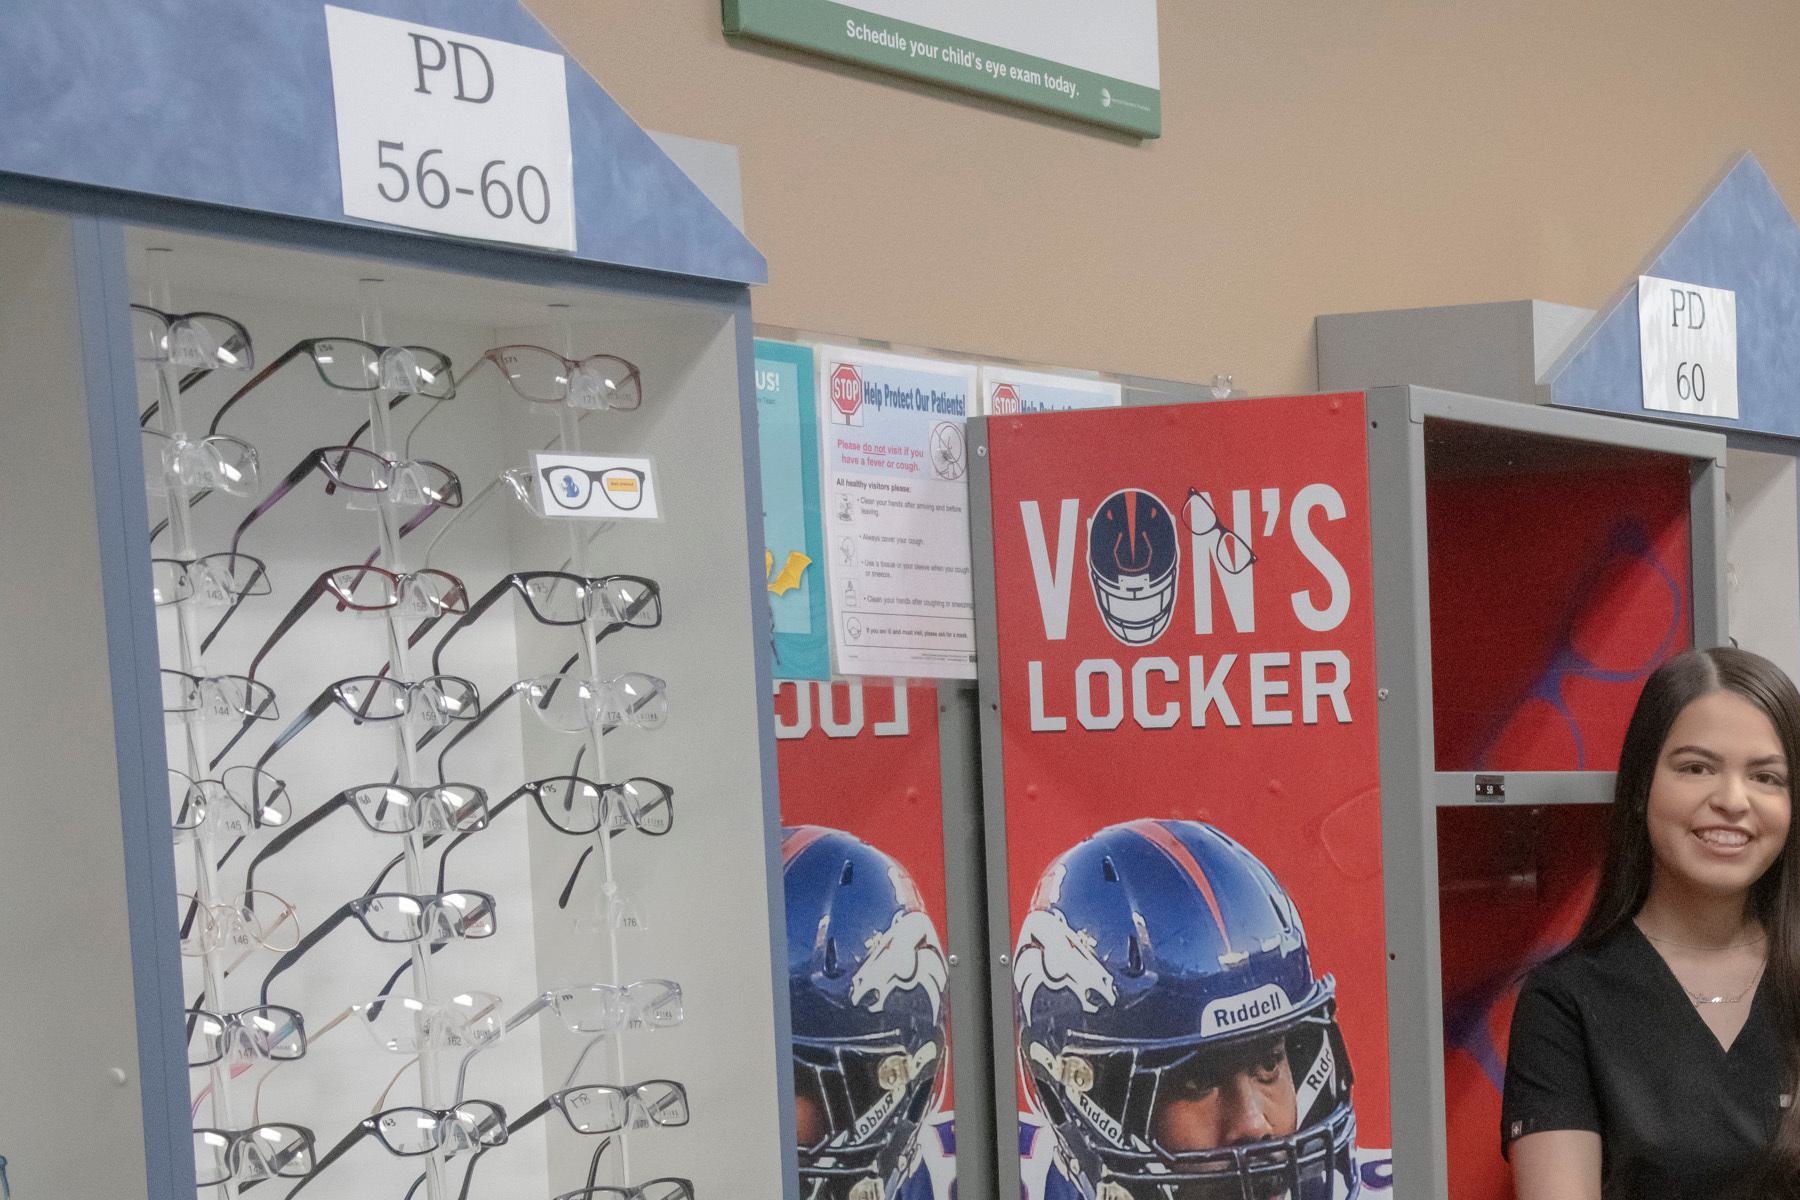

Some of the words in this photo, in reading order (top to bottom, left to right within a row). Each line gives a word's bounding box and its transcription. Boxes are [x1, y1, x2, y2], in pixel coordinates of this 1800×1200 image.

[846, 19, 906, 51] Schedule
[909, 38, 939, 60] your
[941, 45, 983, 71] child's
[985, 60, 1007, 79] eye
[1009, 67, 1041, 86] exam
[1044, 76, 1080, 99] today.
[408, 32, 495, 104] PD
[377, 139, 550, 225] 56-60
[1670, 288, 1705, 330] PD
[1677, 361, 1705, 402] 60
[834, 379, 859, 400] STOP
[863, 381, 882, 412] Help
[884, 384, 914, 411] Protect
[915, 388, 931, 412] Our
[931, 390, 966, 417] Patients!
[837, 438, 860, 451] Please
[863, 442, 873, 453] do
[874, 443, 886, 454] not
[888, 446, 902, 456] visit
[904, 447, 910, 456] if
[910, 448, 924, 459] you
[842, 454, 859, 465] have
[867, 456, 885, 468] fever
[887, 461, 894, 469] or
[845, 479, 867, 490] healthy
[869, 482, 889, 491] visitors
[946, 504, 962, 512] before
[206, 589, 224, 601] 143
[1028, 650, 1353, 732] LOCKER
[213, 705, 230, 717] 144
[607, 711, 621, 721] 174
[225, 819, 242, 832] 145
[623, 918, 637, 927] 176
[232, 934, 249, 946] 146
[1214, 992, 1281, 1028] Riddell
[629, 1020, 642, 1029] 177
[447, 1036, 462, 1047] 162
